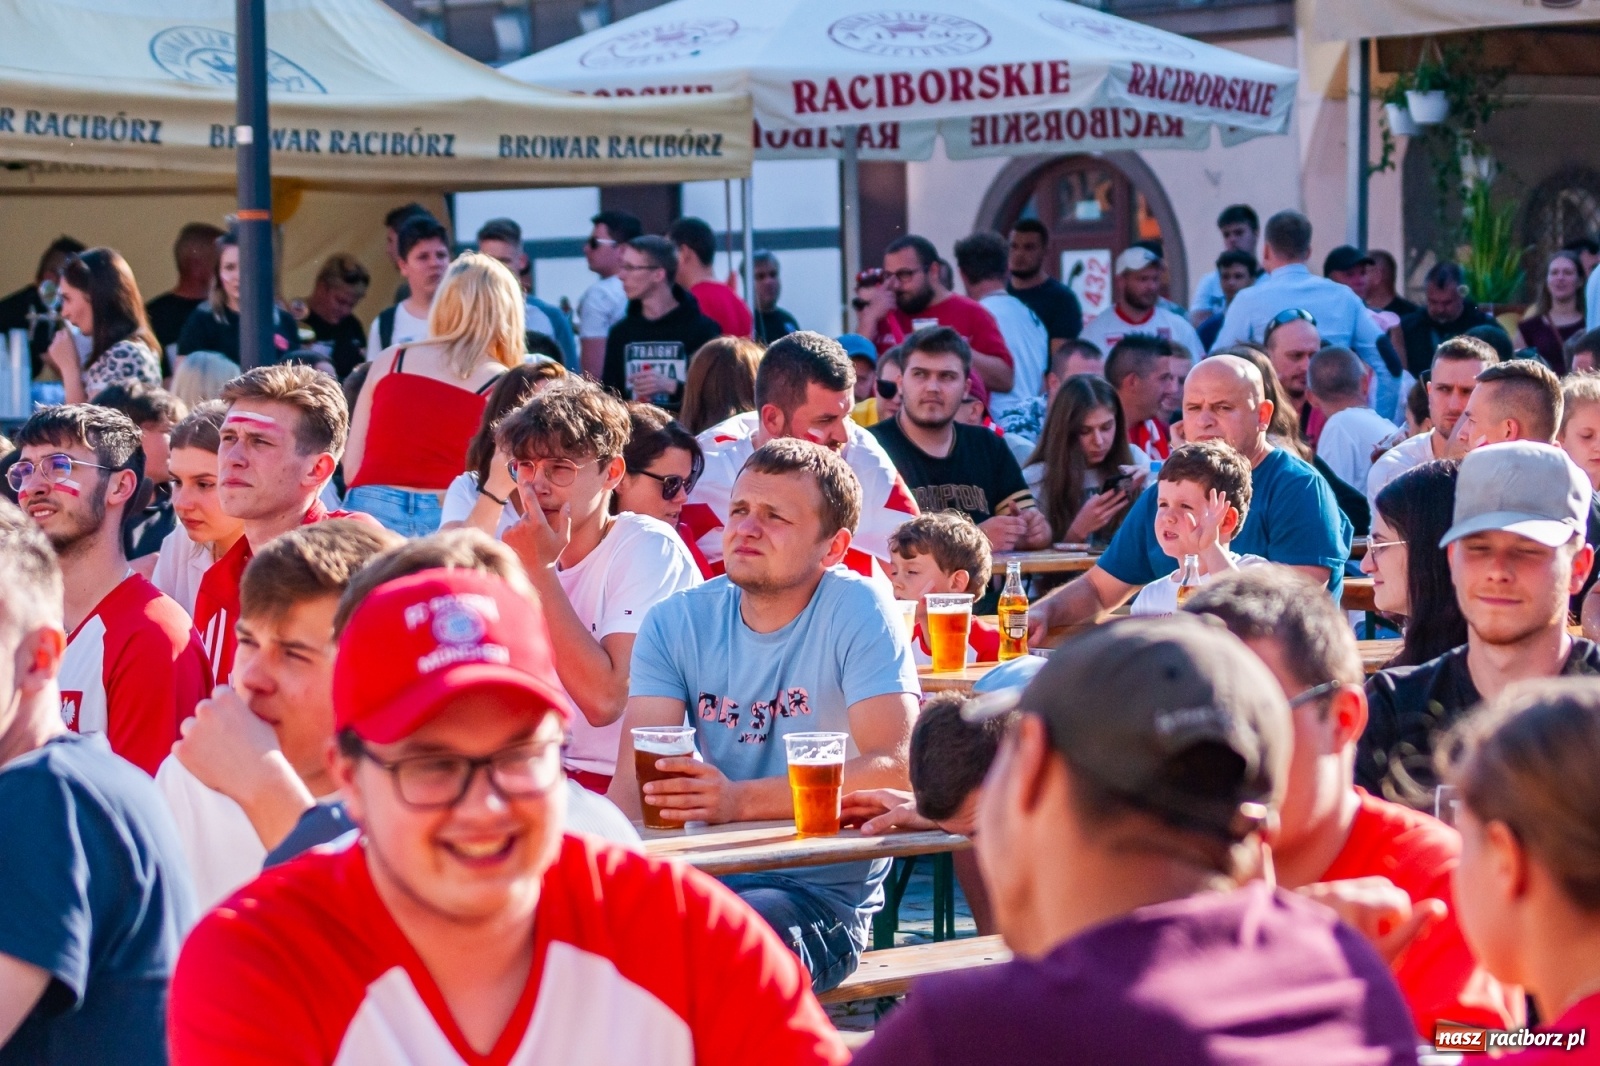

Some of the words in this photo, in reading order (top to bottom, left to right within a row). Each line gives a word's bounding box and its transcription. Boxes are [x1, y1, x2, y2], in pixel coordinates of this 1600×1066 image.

[791, 60, 1071, 115] RACIBORSKIE
[1127, 61, 1278, 117] RACIBORSKIE
[24, 109, 163, 145] RACIBÓRZ
[209, 123, 321, 154] BWAR
[328, 127, 457, 157] RACIBÓRZ
[499, 134, 601, 160] BROWAR
[607, 128, 724, 158] RACIBÓRZ
